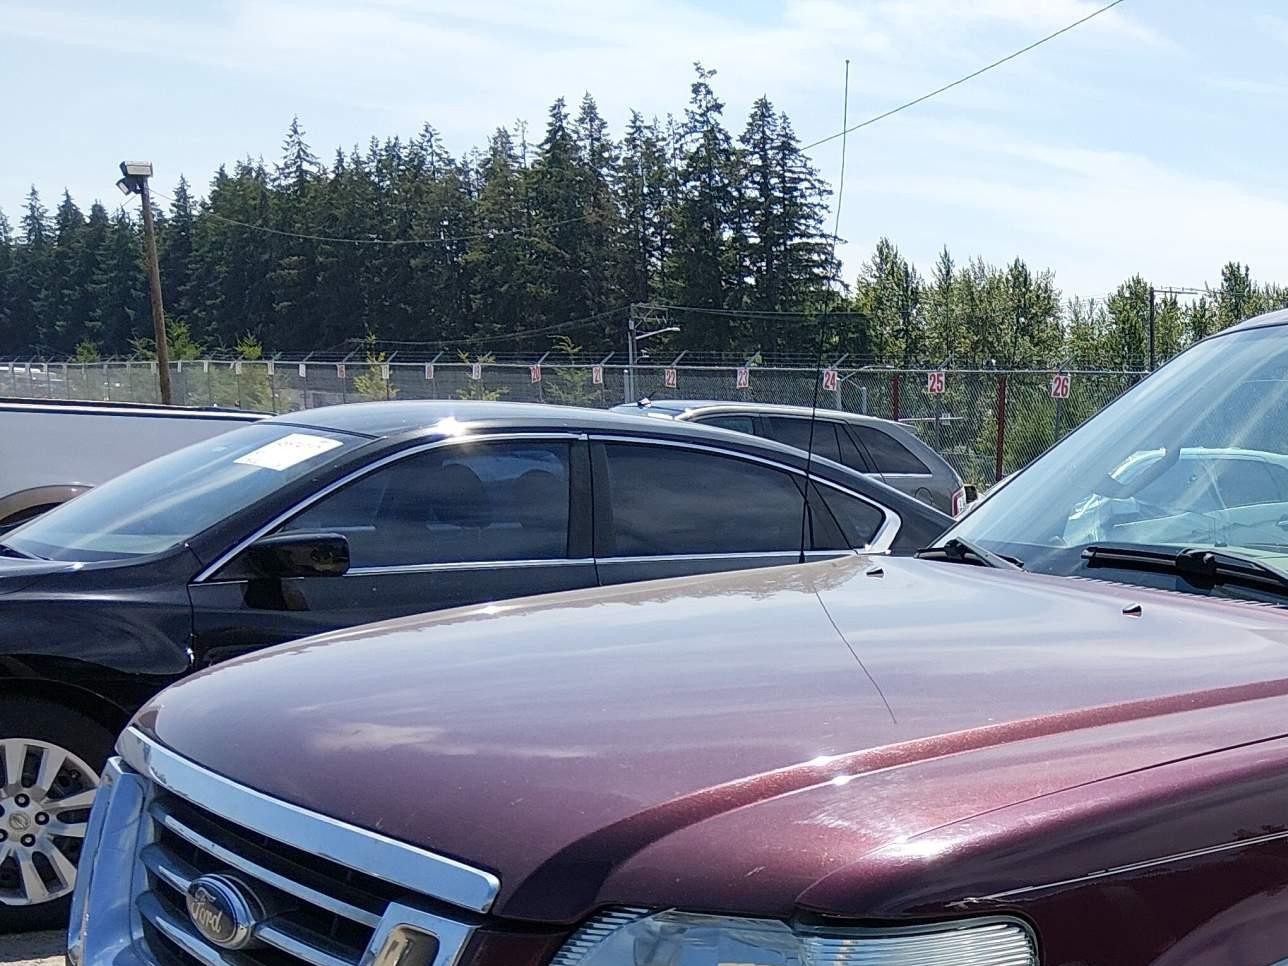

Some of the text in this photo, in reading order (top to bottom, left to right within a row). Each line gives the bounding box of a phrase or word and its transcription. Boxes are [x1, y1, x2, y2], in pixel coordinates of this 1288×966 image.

[666, 370, 676, 386] 22
[738, 369, 748, 386] 23
[824, 371, 836, 390] 24
[929, 373, 944, 393] 25
[1052, 376, 1069, 397] 26
[191, 886, 224, 934] Ford
